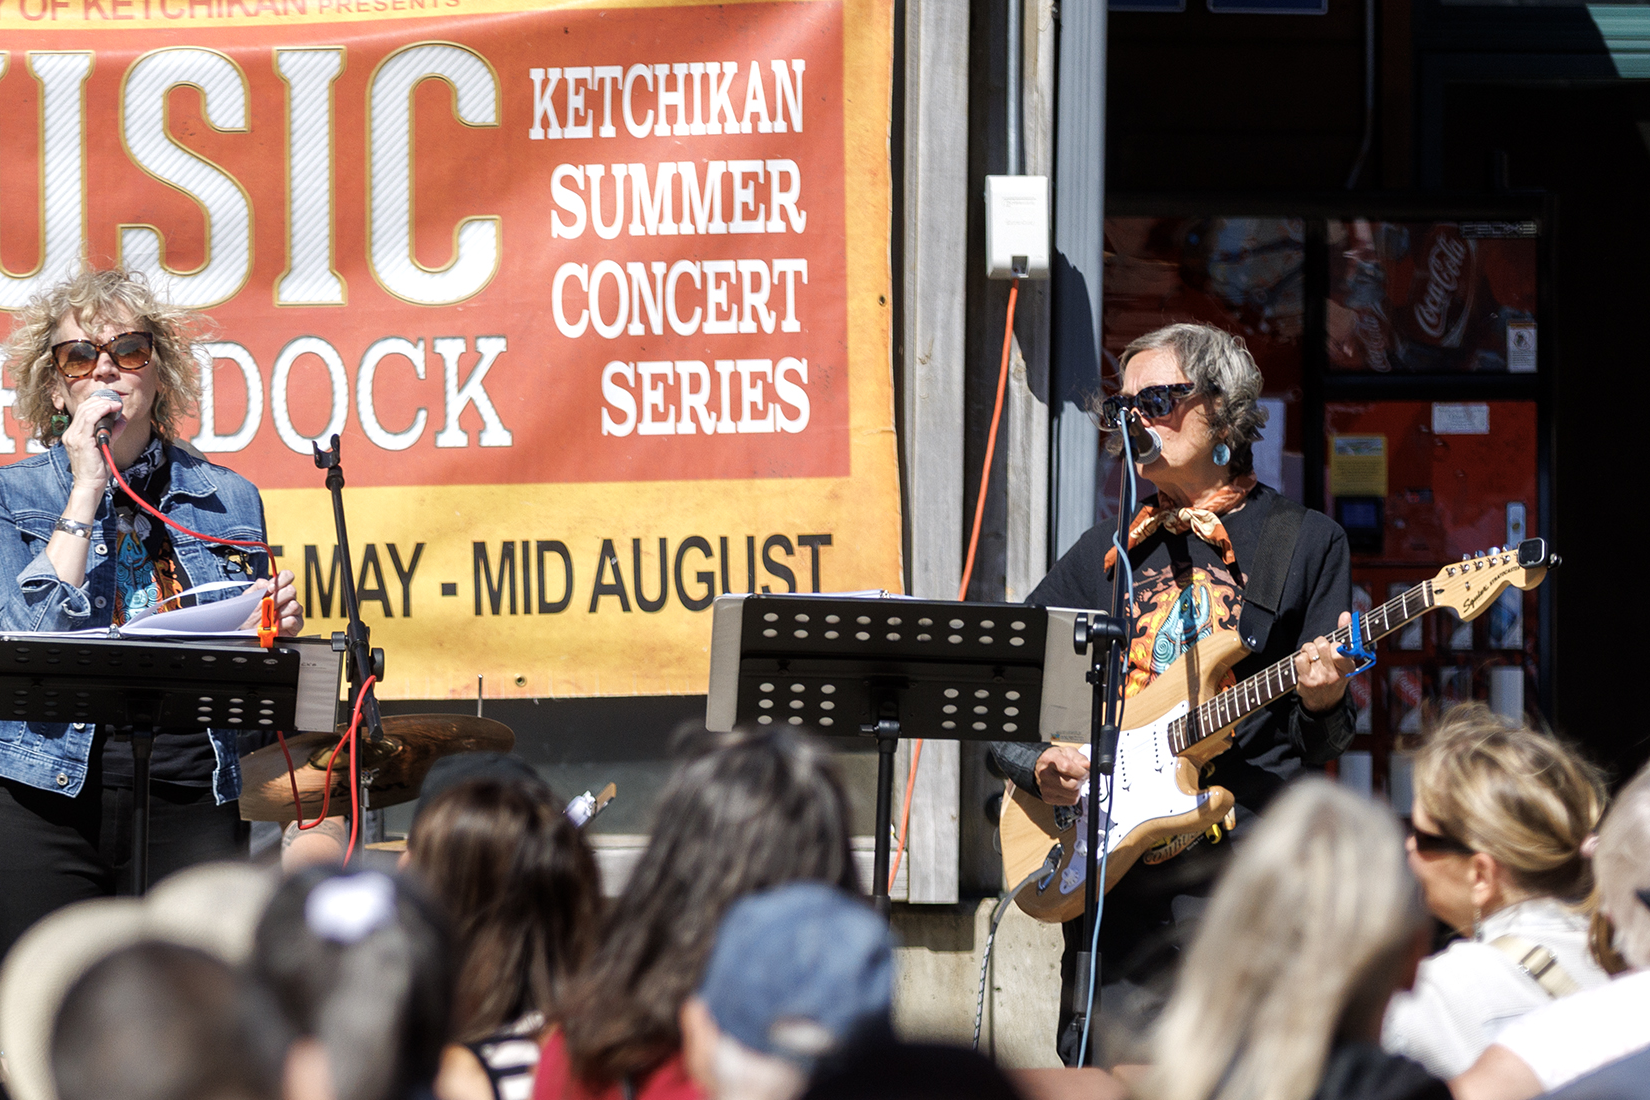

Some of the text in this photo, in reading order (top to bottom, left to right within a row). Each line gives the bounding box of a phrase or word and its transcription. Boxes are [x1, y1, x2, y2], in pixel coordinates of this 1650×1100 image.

[19, 0, 69, 21] OF
[83, 0, 308, 20] KETCHIKAN
[528, 58, 806, 140] KETCHIKAN
[550, 158, 807, 240] SUMMER
[551, 258, 808, 340] CONCERT
[188, 334, 514, 456] DOCK
[601, 356, 811, 437] SERIES
[303, 542, 426, 619] MAY
[441, 582, 458, 598] -
[472, 538, 574, 616] MID
[589, 533, 833, 614] AUGUST
